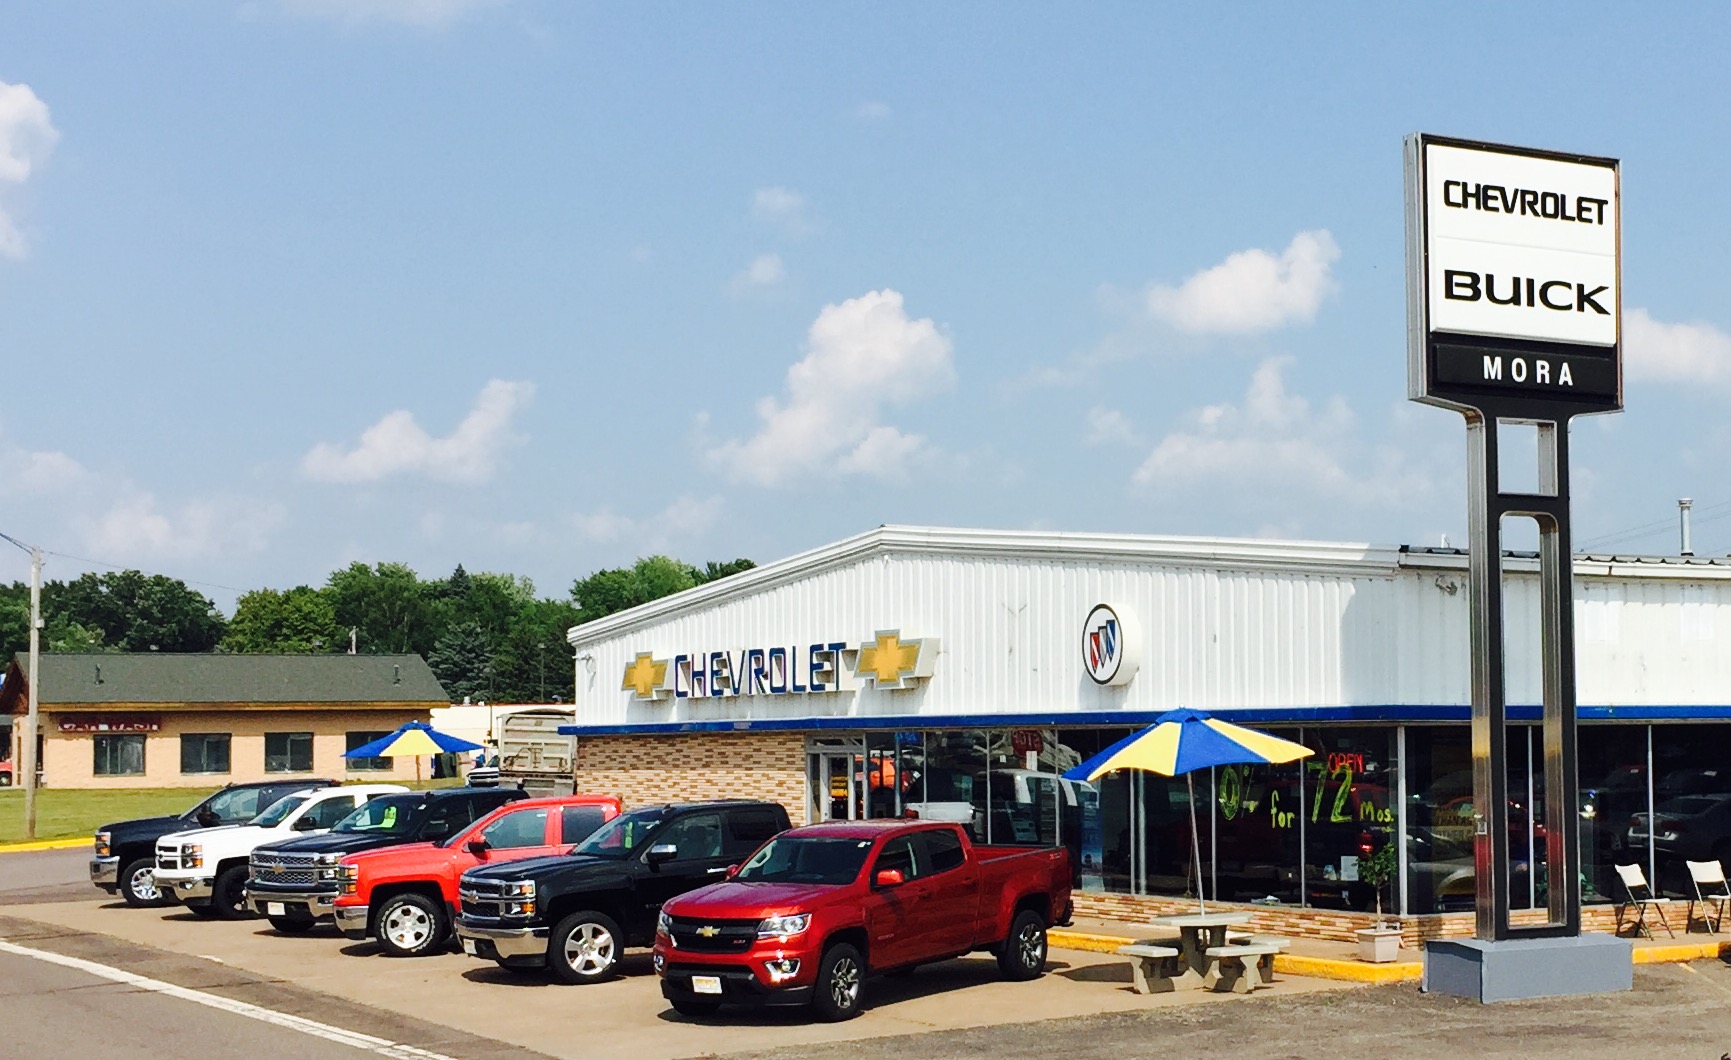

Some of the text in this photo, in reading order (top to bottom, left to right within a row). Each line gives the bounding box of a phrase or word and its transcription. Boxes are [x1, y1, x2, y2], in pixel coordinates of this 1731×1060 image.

[1443, 179, 1609, 225] CHEVROLET
[1444, 269, 1611, 315] BUICK
[1483, 355, 1574, 386] MORA
[674, 642, 847, 698] CHEVROLET
[1328, 753, 1364, 774] OPEN
[1270, 790, 1295, 829] for
[1307, 762, 1353, 824] 72
